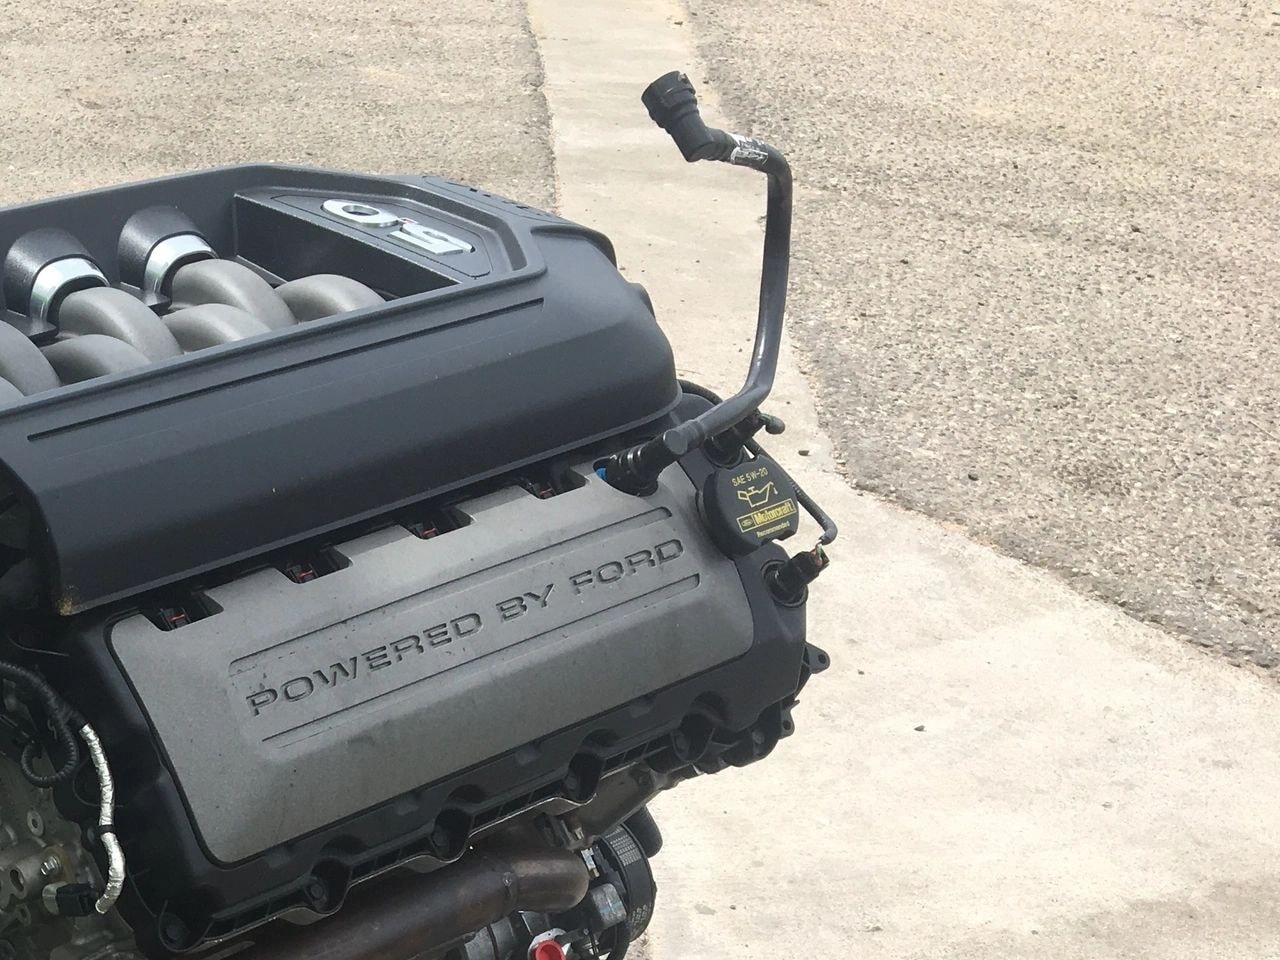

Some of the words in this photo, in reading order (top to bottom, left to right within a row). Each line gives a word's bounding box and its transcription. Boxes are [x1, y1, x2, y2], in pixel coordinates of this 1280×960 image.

[731, 474, 746, 487] SAE
[745, 467, 769, 483] 5W-20
[753, 502, 794, 525] Motorcraft
[245, 611, 483, 717] POWERED
[495, 583, 555, 623] BY
[569, 538, 685, 594] FORD
